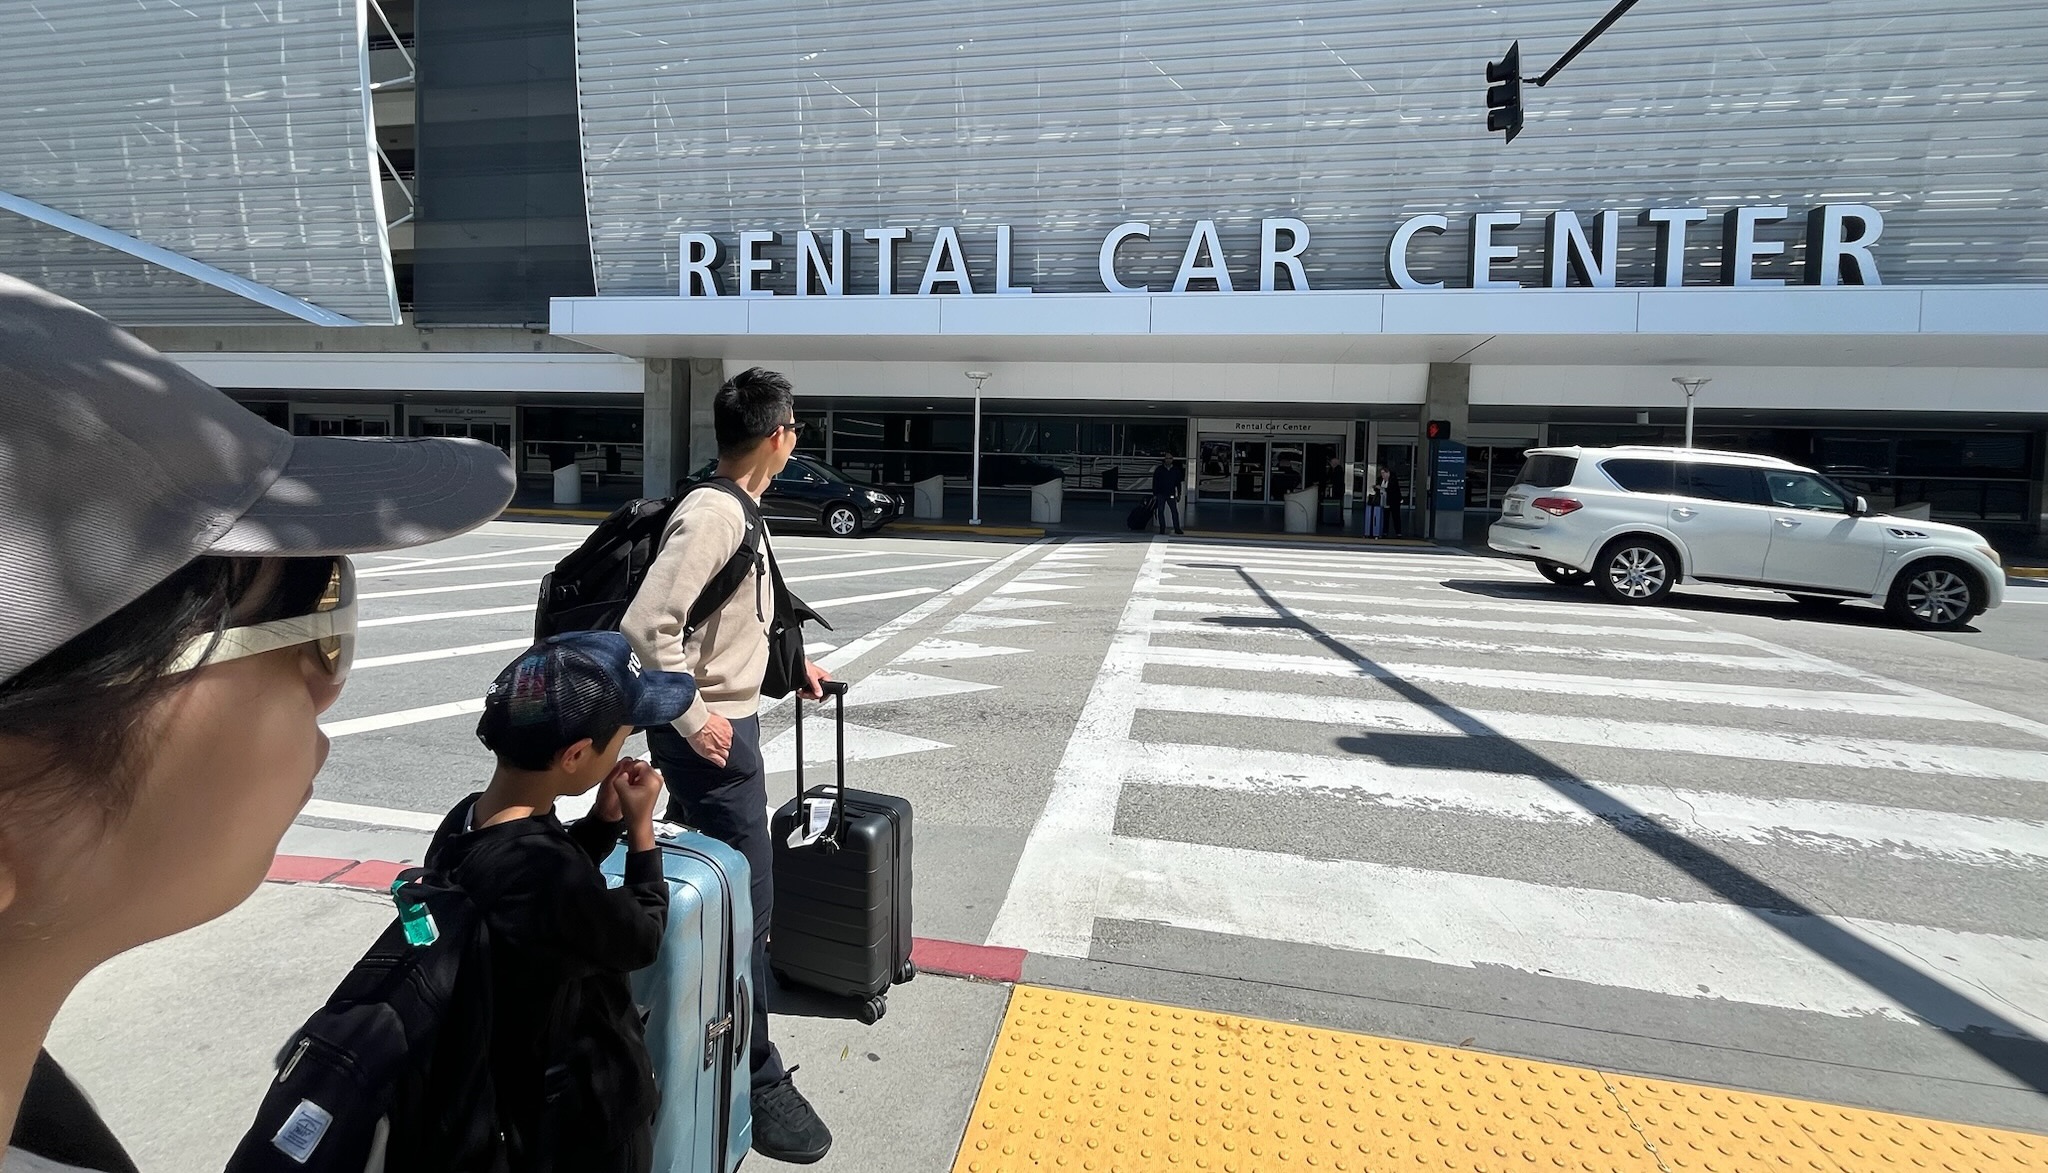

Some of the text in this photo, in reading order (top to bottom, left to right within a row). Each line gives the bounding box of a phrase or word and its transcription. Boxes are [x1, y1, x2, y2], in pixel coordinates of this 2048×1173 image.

[679, 204, 1885, 297] RENTAL CAR CENTER
[1235, 422, 1263, 430] Rental
[1282, 423, 1312, 431] Center
[626, 648, 642, 679] TO
